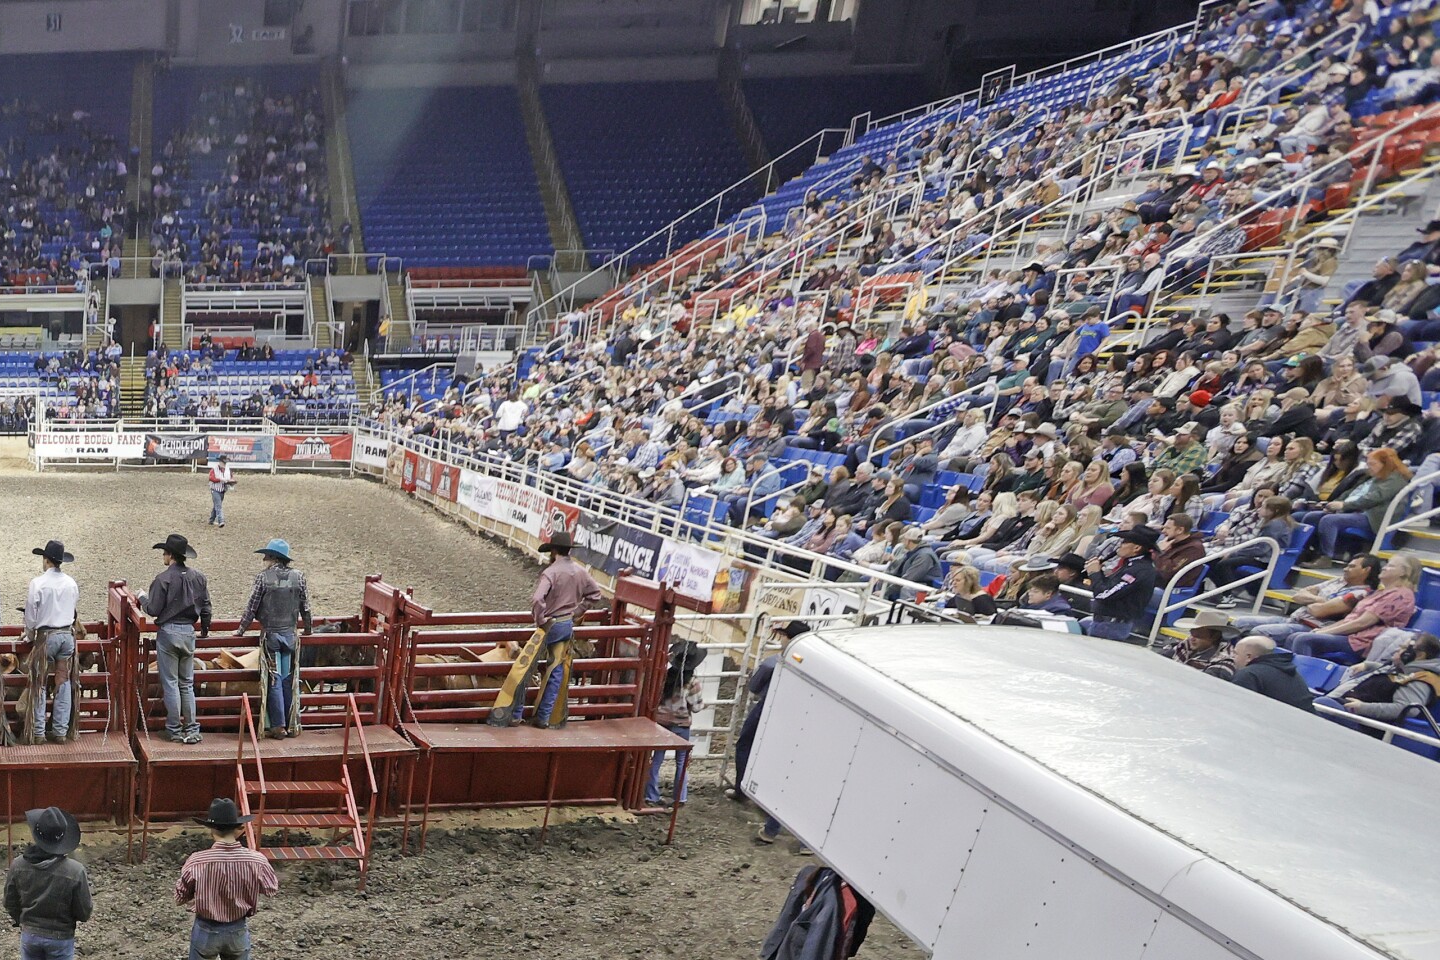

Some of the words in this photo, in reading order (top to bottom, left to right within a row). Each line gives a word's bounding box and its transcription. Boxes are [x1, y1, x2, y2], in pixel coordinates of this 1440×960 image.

[229, 22, 244, 44] 32
[36, 434, 80, 445] WELCOME
[85, 434, 113, 445] RODEO
[117, 434, 142, 445] FANS
[160, 438, 205, 450] PENDLETON
[213, 437, 238, 446] TITAN
[295, 443, 312, 455] TWIN
[312, 443, 331, 455] PEAKS
[365, 446, 387, 458] RAM
[613, 537, 655, 572] CINCH
